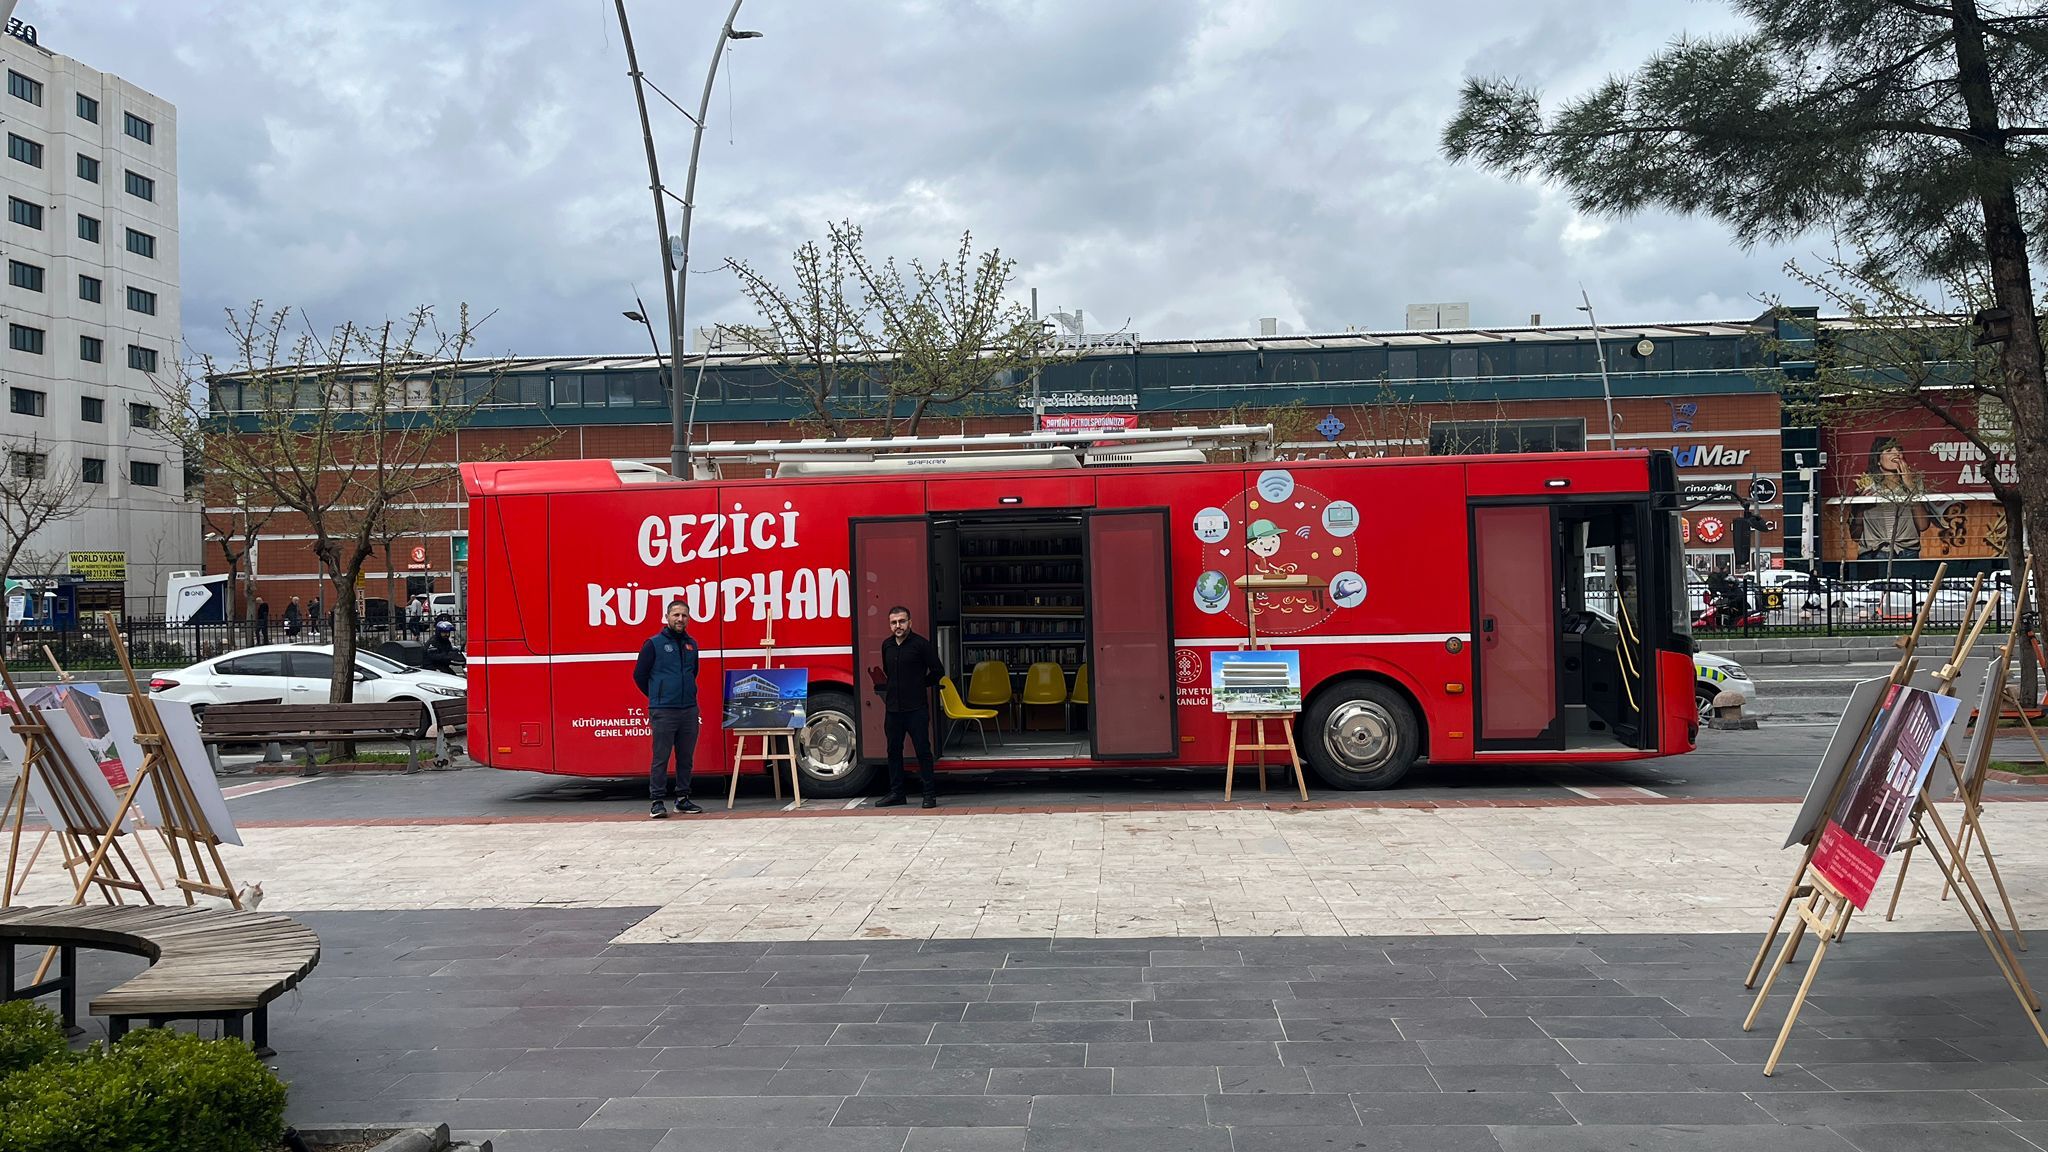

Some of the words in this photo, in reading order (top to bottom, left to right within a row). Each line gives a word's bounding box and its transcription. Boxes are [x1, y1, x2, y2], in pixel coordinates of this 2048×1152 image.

[1018, 394, 1047, 408] Cae
[1671, 445, 1751, 467] ldMar
[638, 501, 800, 567] GEZİCİ
[100, 554, 124, 564] YAŞAM
[587, 567, 851, 627] KÜTÜPHAN
[1176, 686, 1188, 696] ÜR
[1200, 687, 1211, 695] TU
[1176, 696, 1209, 706] KANLIĞI
[627, 708, 644, 716] T.C.
[572, 717, 642, 728] KÜTÜPHANELER
[594, 728, 623, 737] GENEL
[624, 726, 653, 736] MÜDÜ
